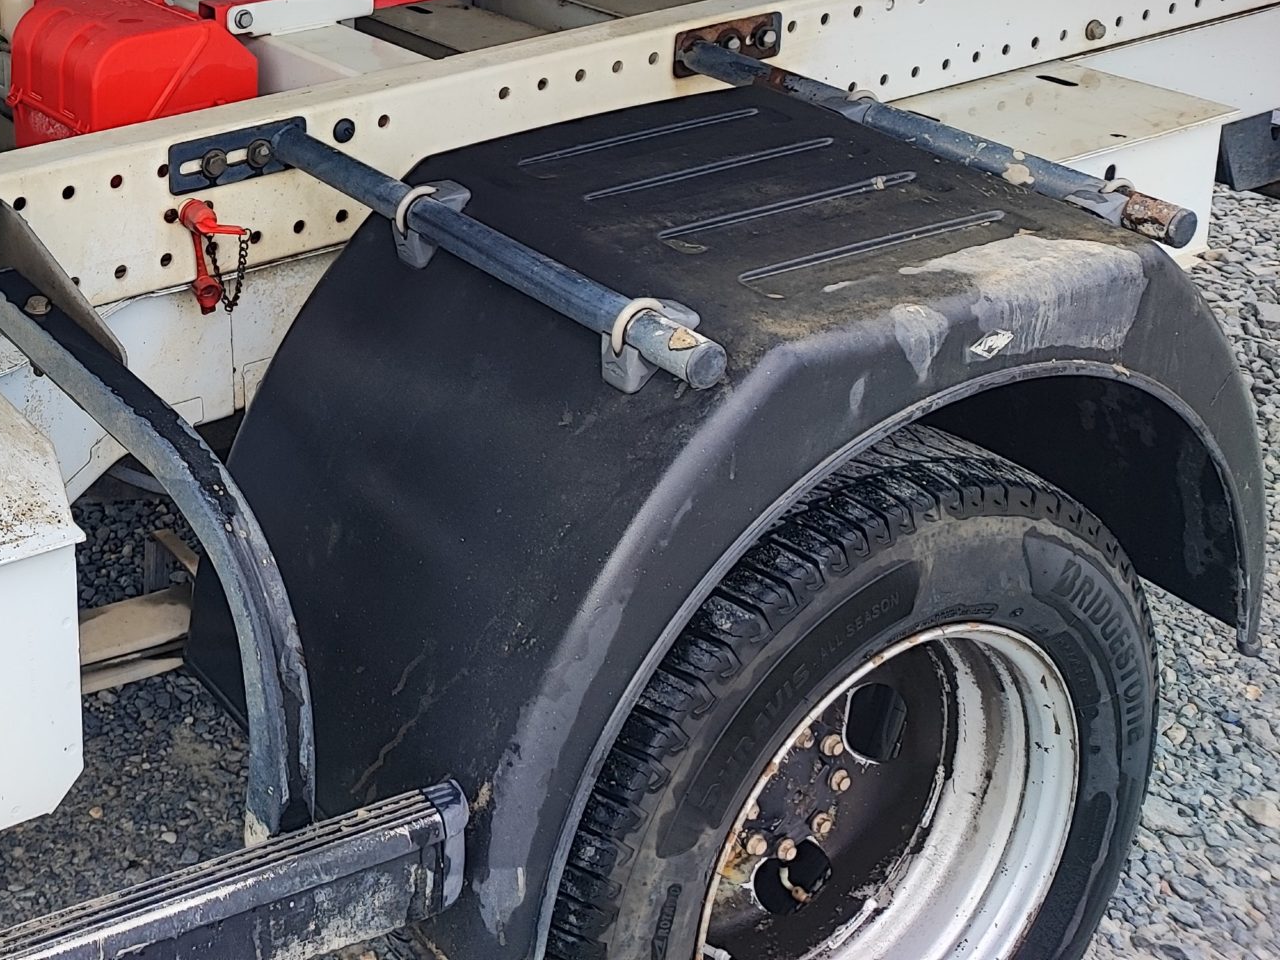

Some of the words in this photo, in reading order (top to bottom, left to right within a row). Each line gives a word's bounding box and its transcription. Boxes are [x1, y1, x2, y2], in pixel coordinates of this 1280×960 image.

[821, 634, 843, 658] ALL
[846, 592, 900, 638] SEASON
[1051, 558, 1146, 746] BRIDGESTONE
